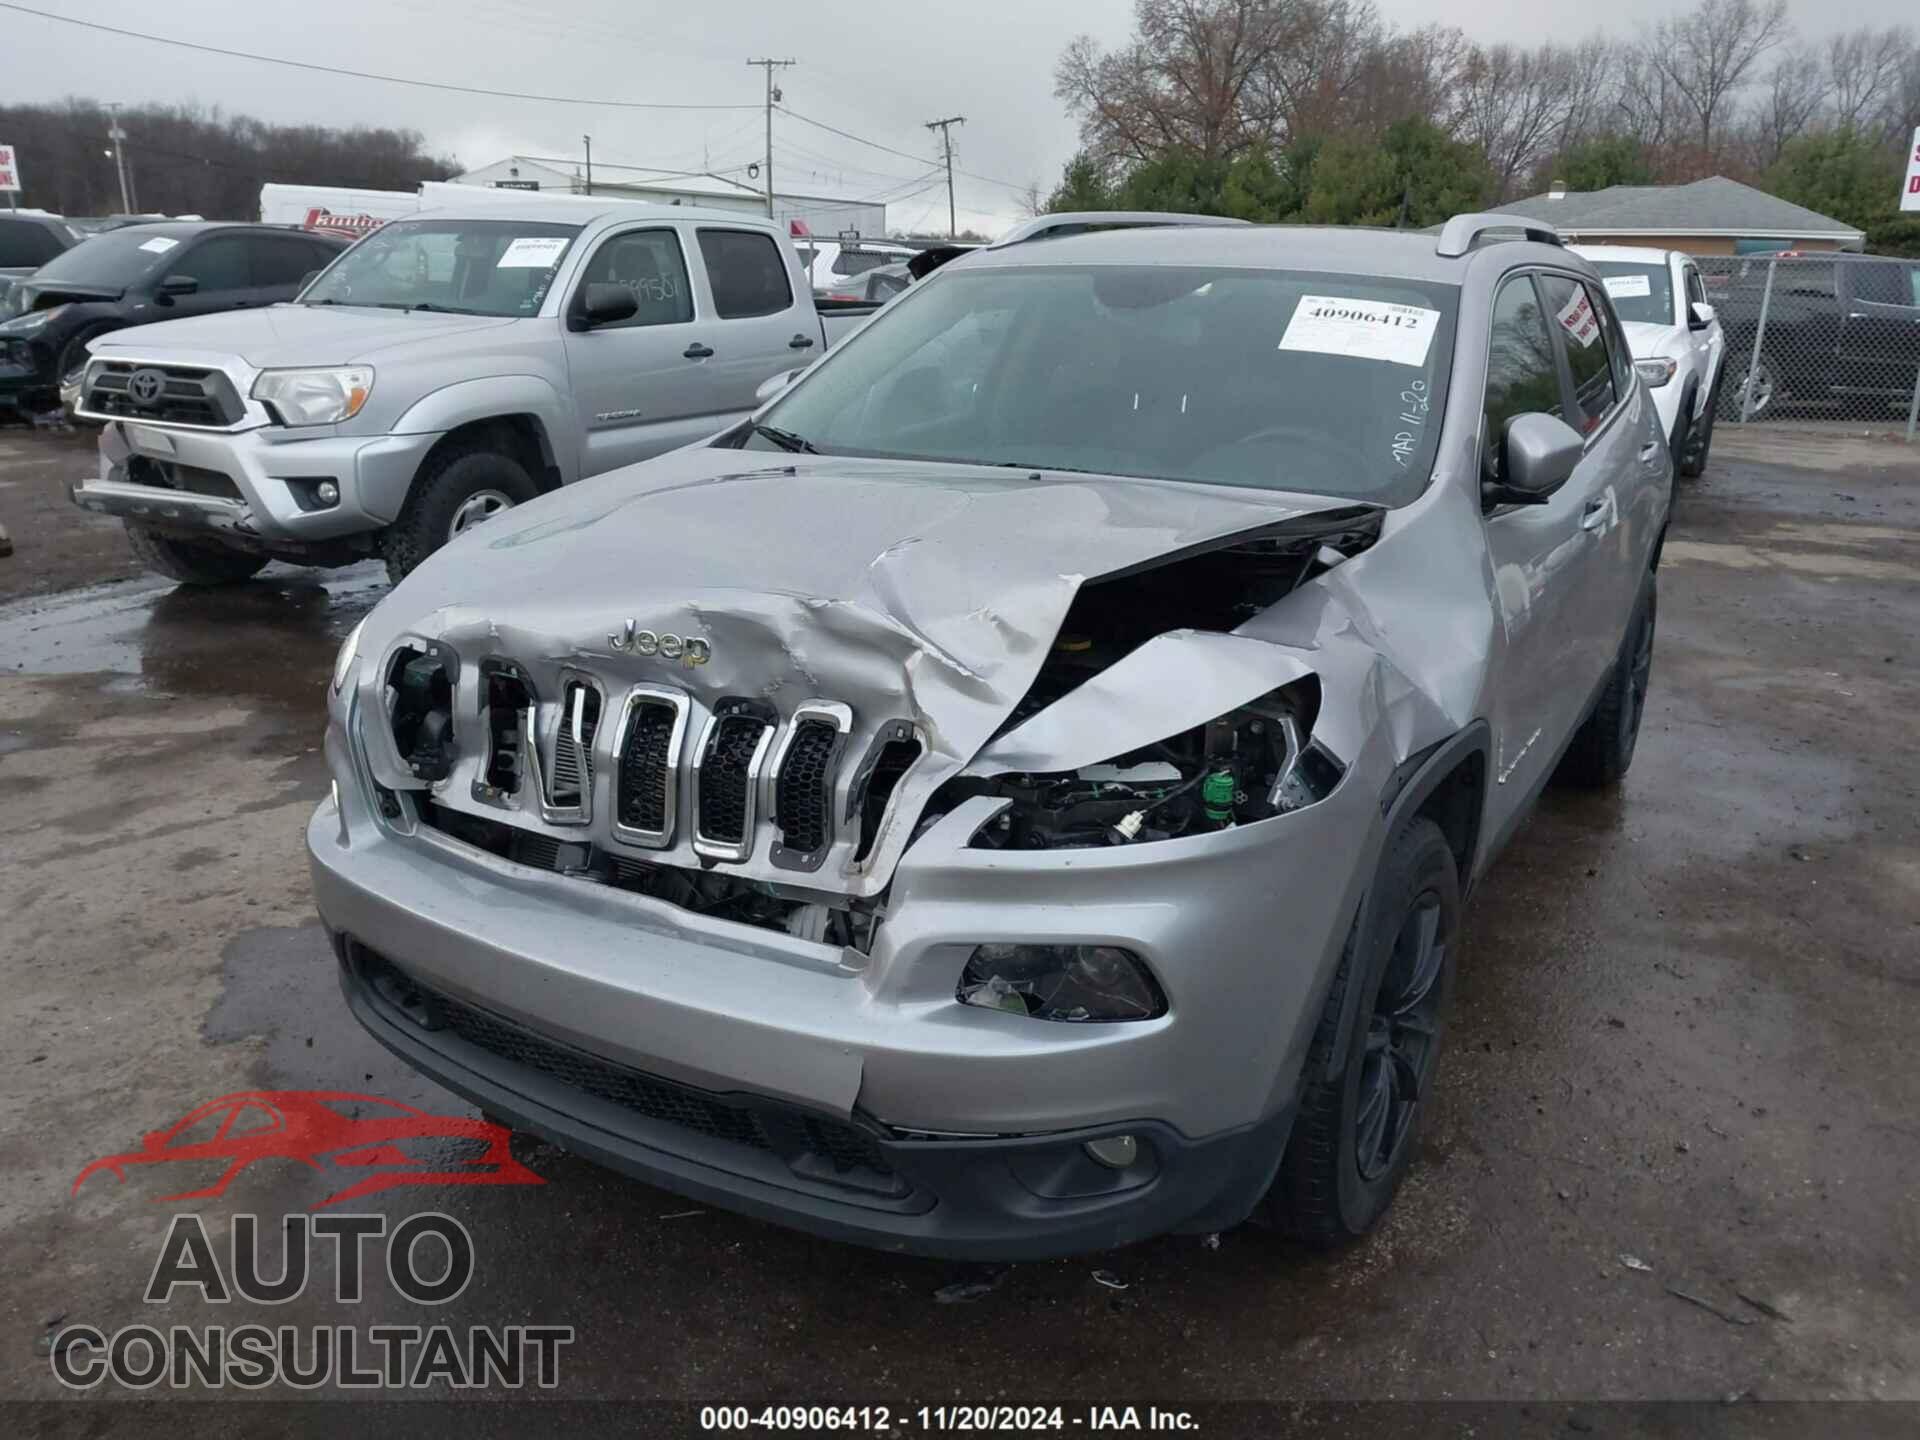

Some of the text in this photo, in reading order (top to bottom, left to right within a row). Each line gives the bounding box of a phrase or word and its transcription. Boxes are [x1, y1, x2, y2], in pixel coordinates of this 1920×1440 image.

[1308, 306, 1418, 329] 40906412
[1399, 380, 1430, 425] 11-20
[607, 618, 712, 670] Jeep
